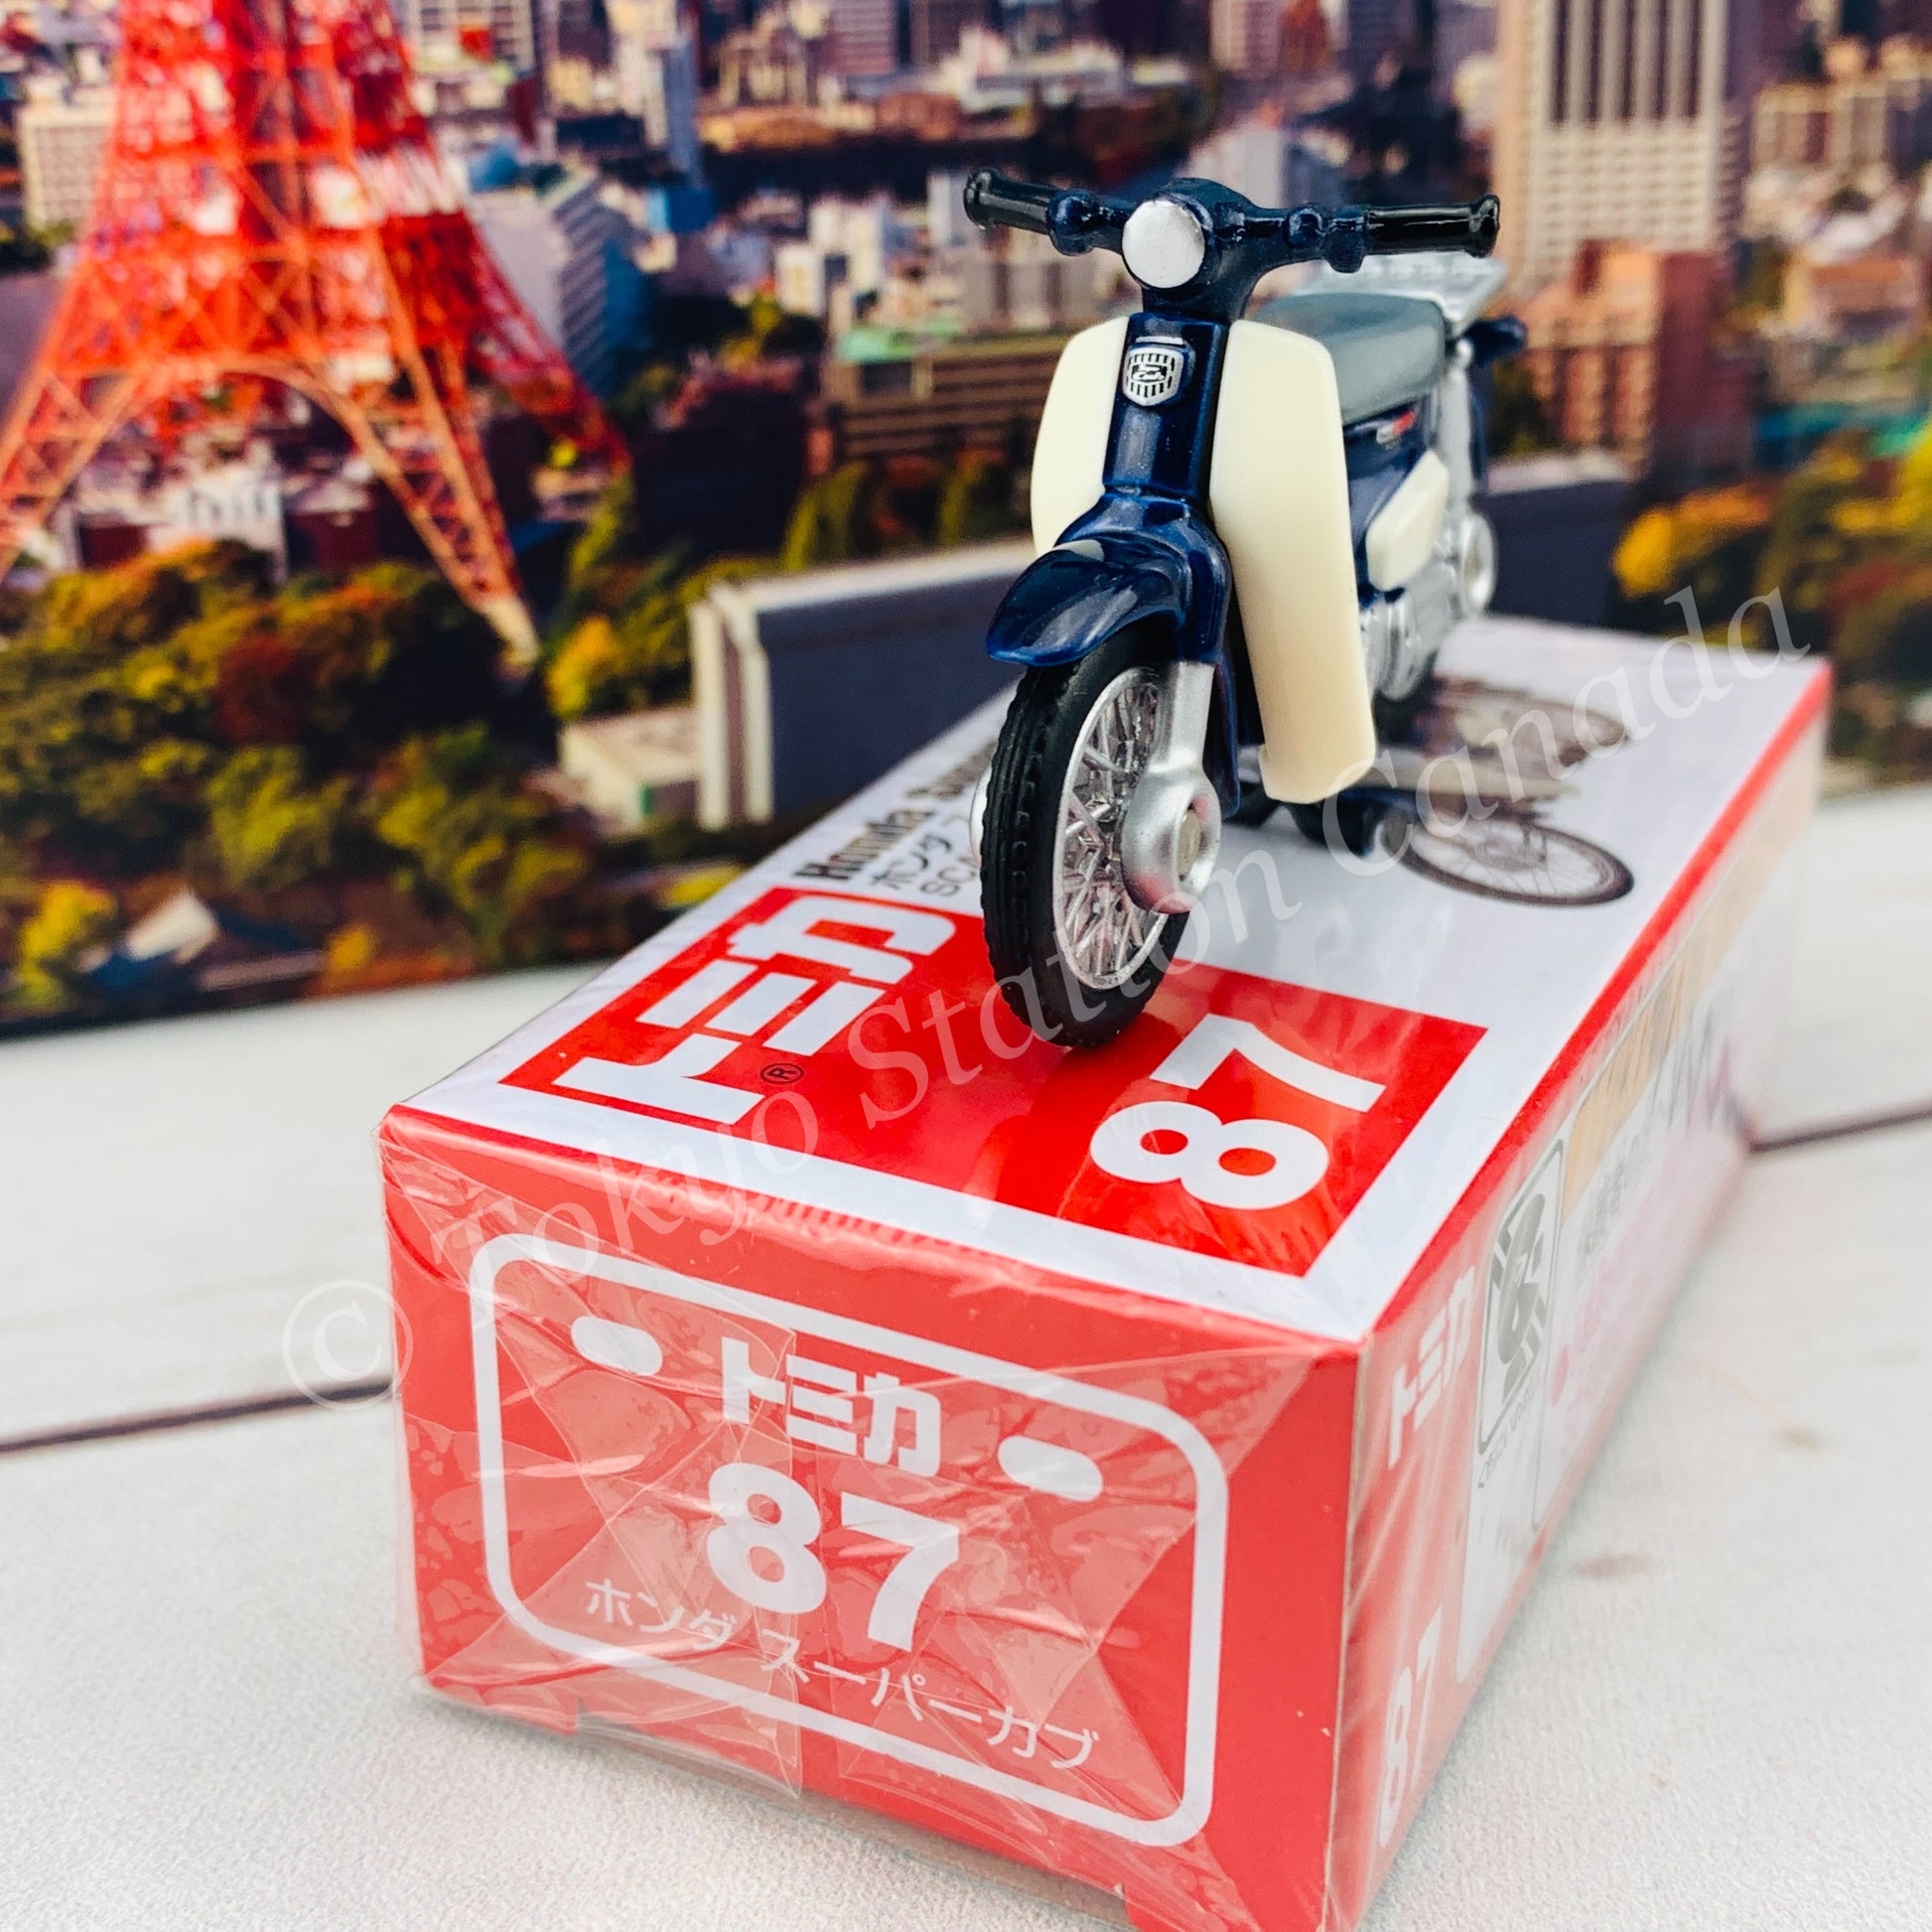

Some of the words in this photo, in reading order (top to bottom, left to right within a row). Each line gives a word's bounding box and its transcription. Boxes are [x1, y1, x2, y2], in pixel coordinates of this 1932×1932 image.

[552, 895, 956, 1125] トミカ
[1089, 1013, 1387, 1209] 87
[721, 1336, 941, 1477] トミカ
[1388, 1266, 1474, 1469] トミカ
[706, 1461, 959, 1651] 87
[1379, 1603, 1442, 1848] 87
